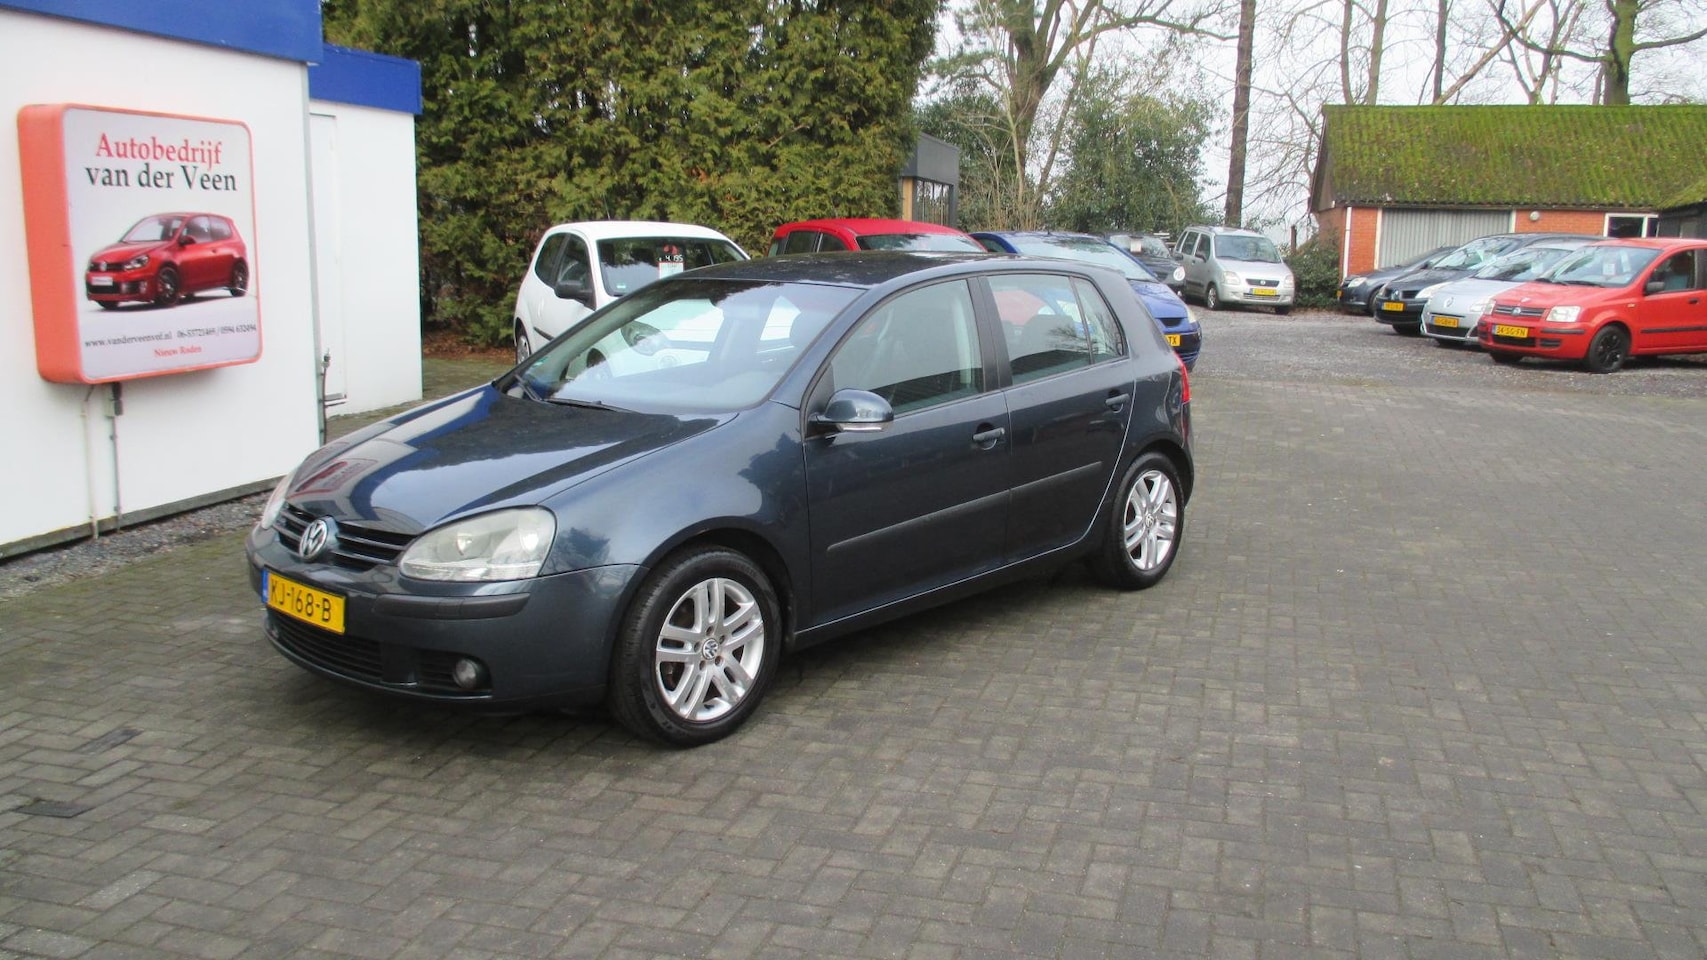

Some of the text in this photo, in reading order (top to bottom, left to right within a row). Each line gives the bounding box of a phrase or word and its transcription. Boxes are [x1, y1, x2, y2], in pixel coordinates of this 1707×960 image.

[96, 132, 222, 169] Autobedrijf
[85, 162, 237, 191] van der Veen
[270, 578, 331, 622] KJ-168-B
